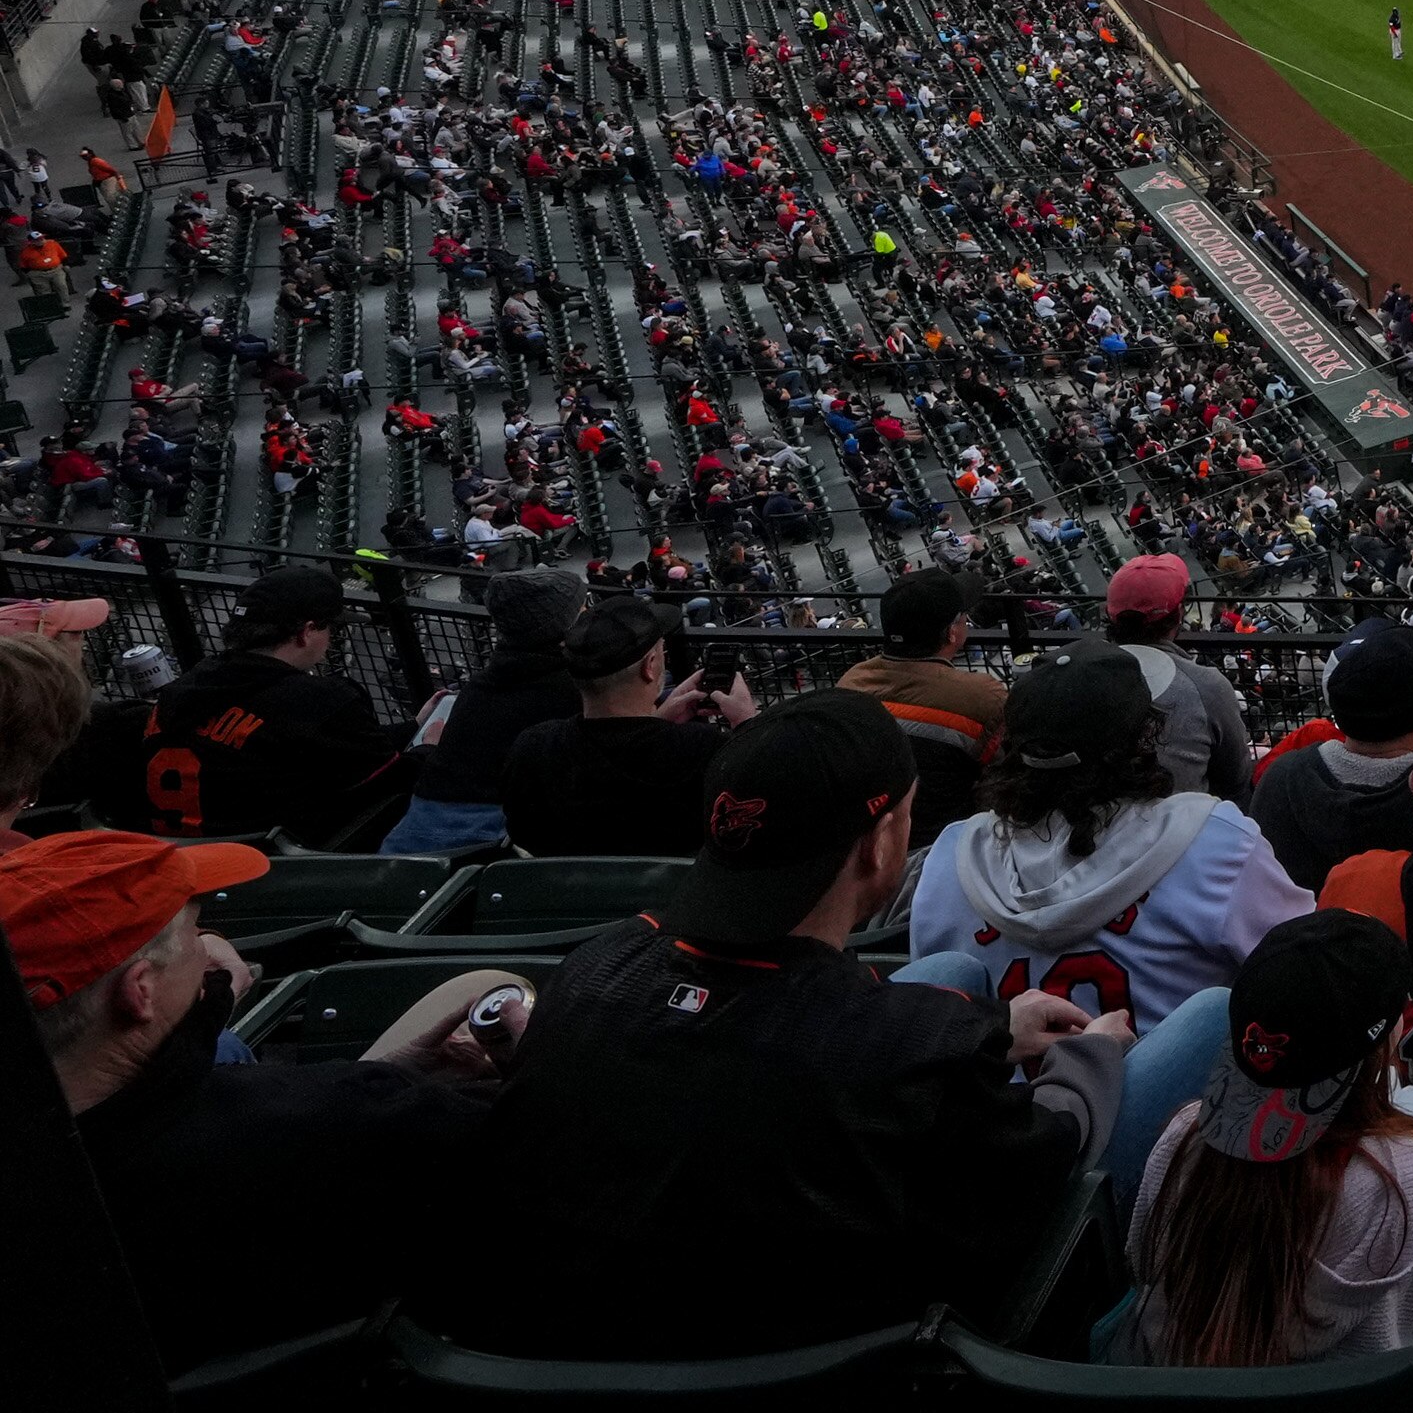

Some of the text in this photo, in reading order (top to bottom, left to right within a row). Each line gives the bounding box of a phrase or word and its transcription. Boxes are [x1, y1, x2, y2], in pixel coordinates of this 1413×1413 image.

[1169, 203, 1353, 379] WELCOME TO ORIOLE PARK
[145, 747, 202, 835] 9
